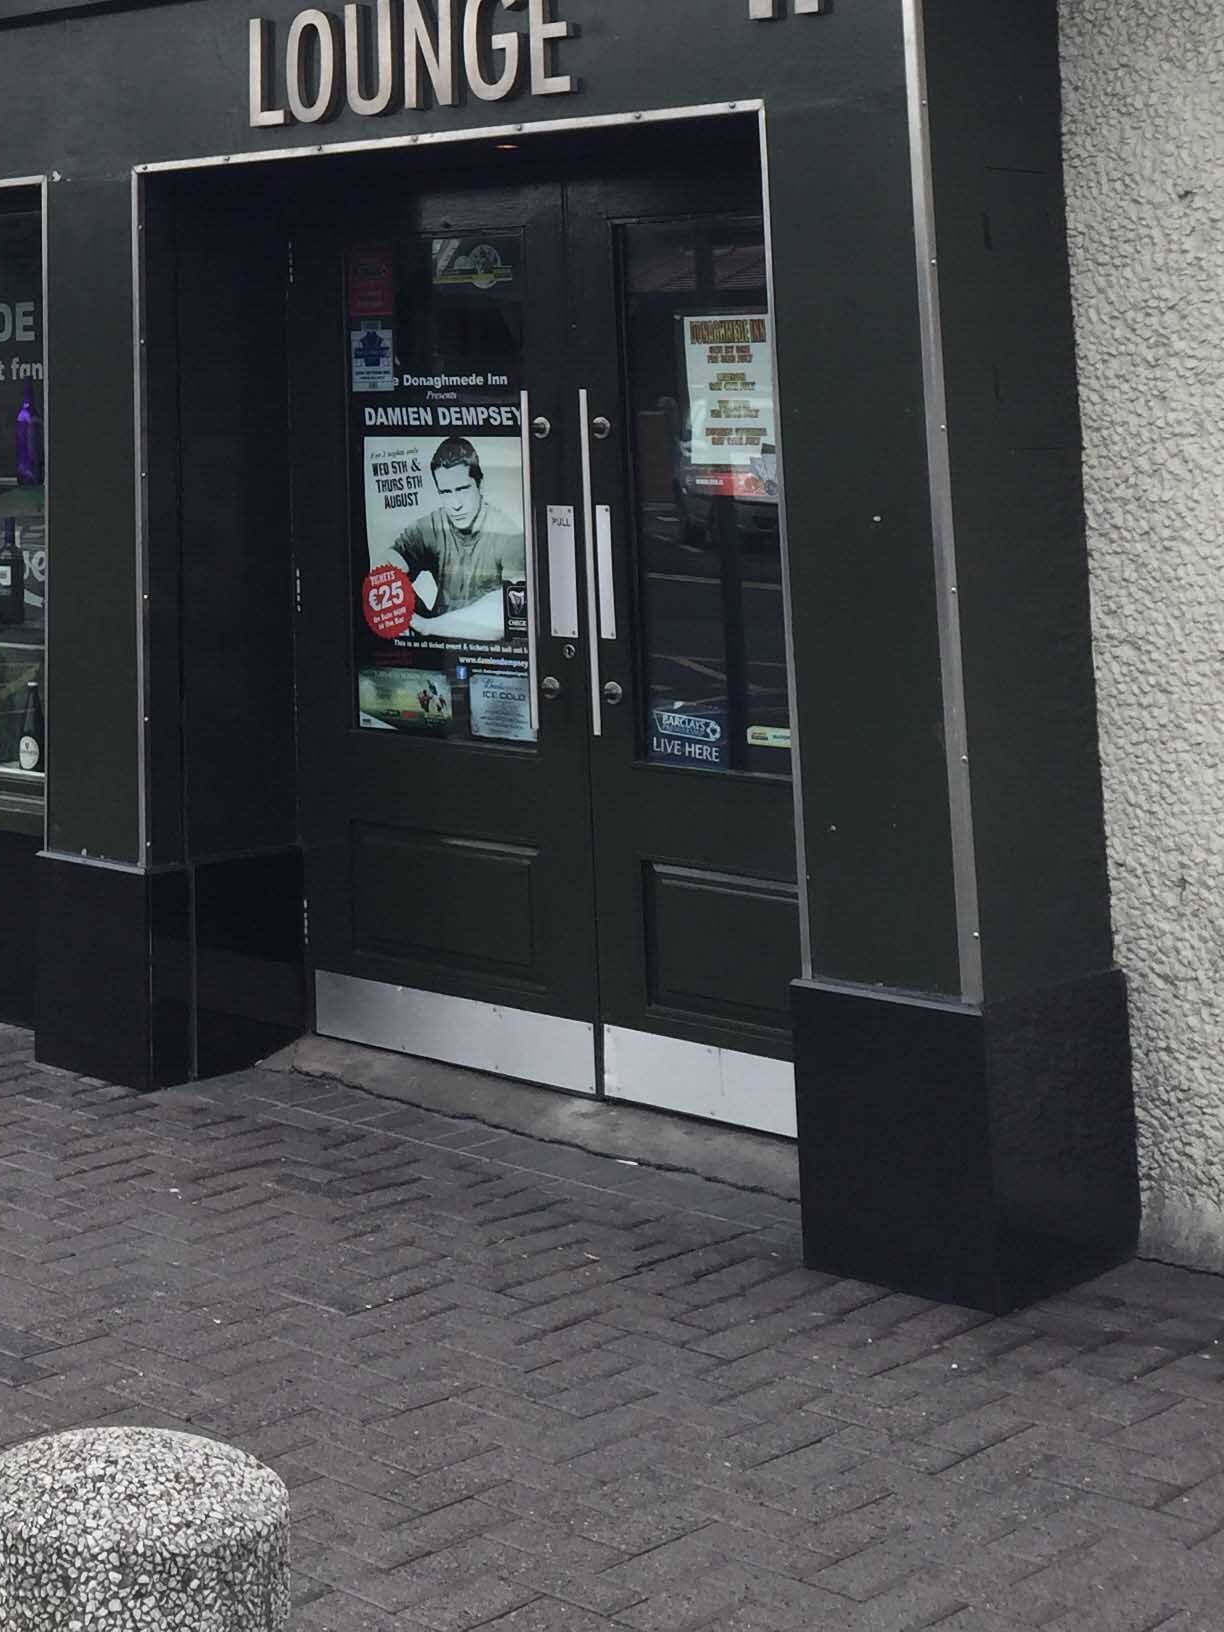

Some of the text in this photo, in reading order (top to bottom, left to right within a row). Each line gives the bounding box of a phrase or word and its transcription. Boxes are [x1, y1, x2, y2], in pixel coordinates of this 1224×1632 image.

[403, 373, 484, 389] Donaghmede
[488, 373, 508, 385] Inn
[364, 406, 521, 426] DAMIEN DEMPSEY
[371, 457, 421, 477] WED 5TH &
[376, 475, 423, 493] THURS 6TH
[384, 492, 419, 509] AUGUST
[551, 517, 571, 527] PULL
[369, 571, 395, 586] TICKETS
[368, 580, 404, 611] €25
[394, 639, 406, 647] This
[662, 715, 705, 730] BARCLAYS
[652, 736, 720, 762] LIVE HERE
